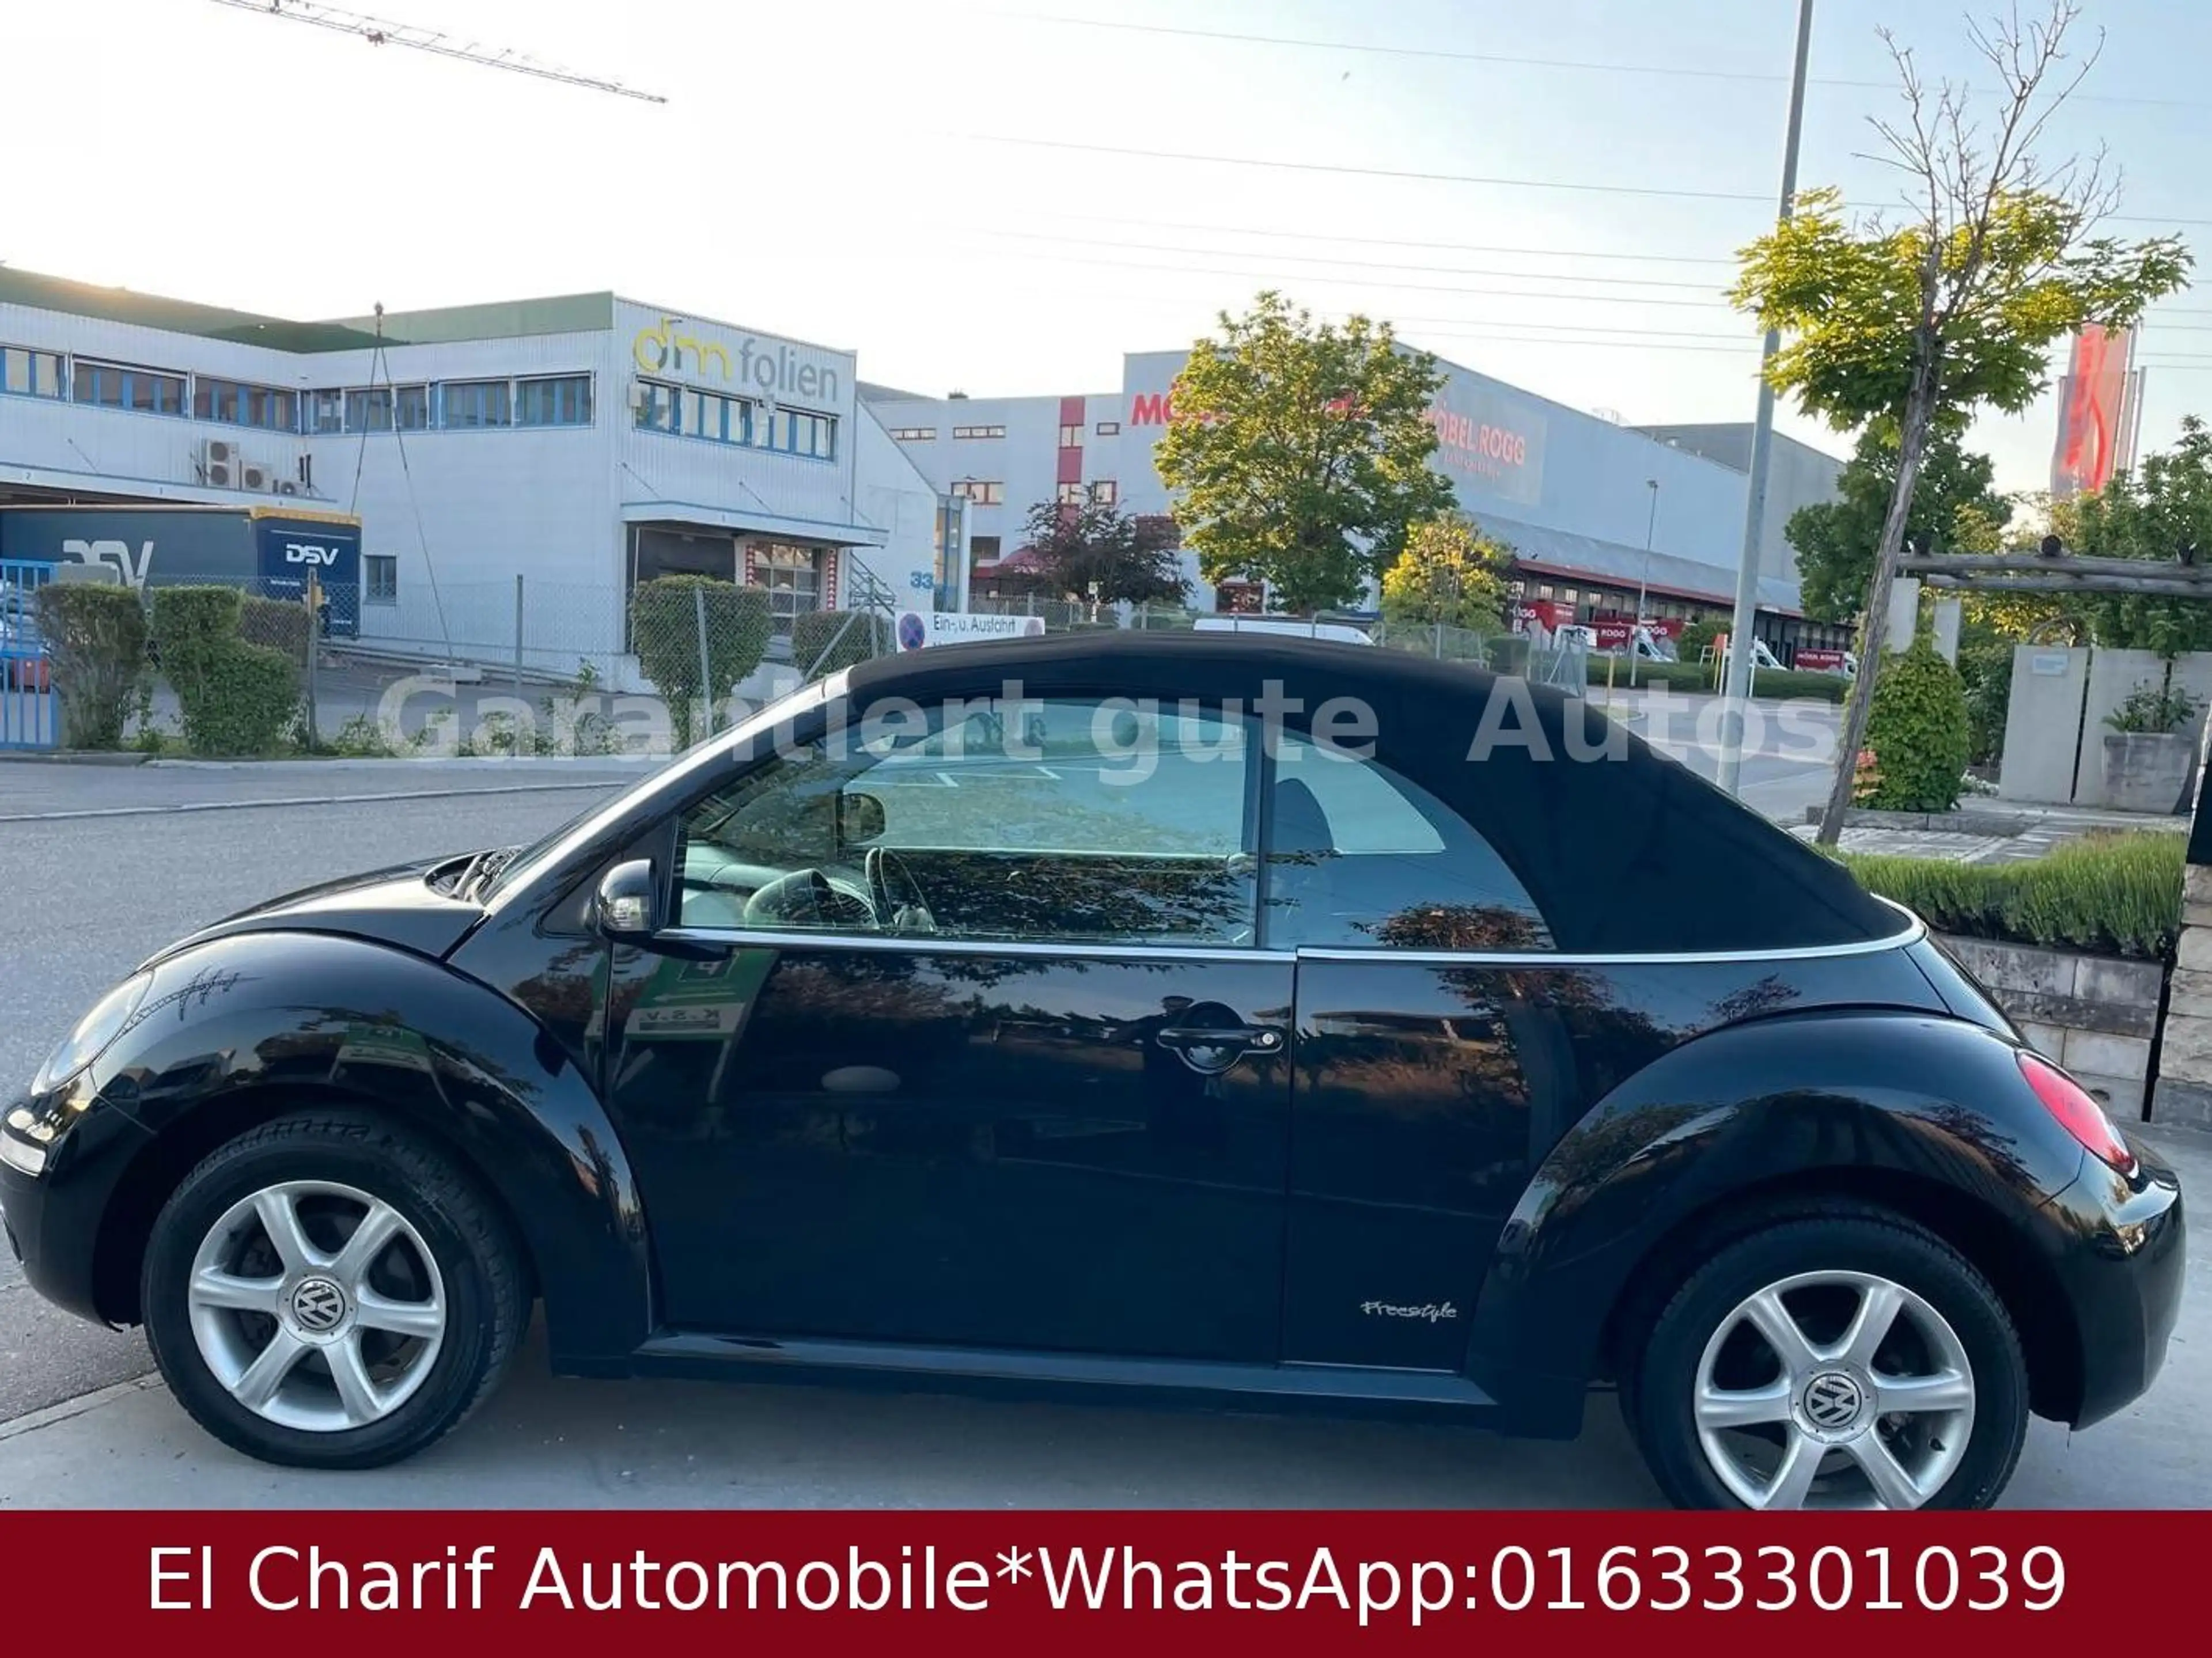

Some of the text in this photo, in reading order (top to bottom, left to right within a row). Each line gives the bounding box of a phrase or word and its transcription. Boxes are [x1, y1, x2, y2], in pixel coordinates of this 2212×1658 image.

[634, 317, 838, 402] dm folien
[1479, 423, 1525, 466] ROGG
[286, 543, 339, 566] DSV
[910, 570, 934, 589] 33
[971, 616, 1016, 633] Ausfahrt
[1360, 1301, 1457, 1323] Freestyle
